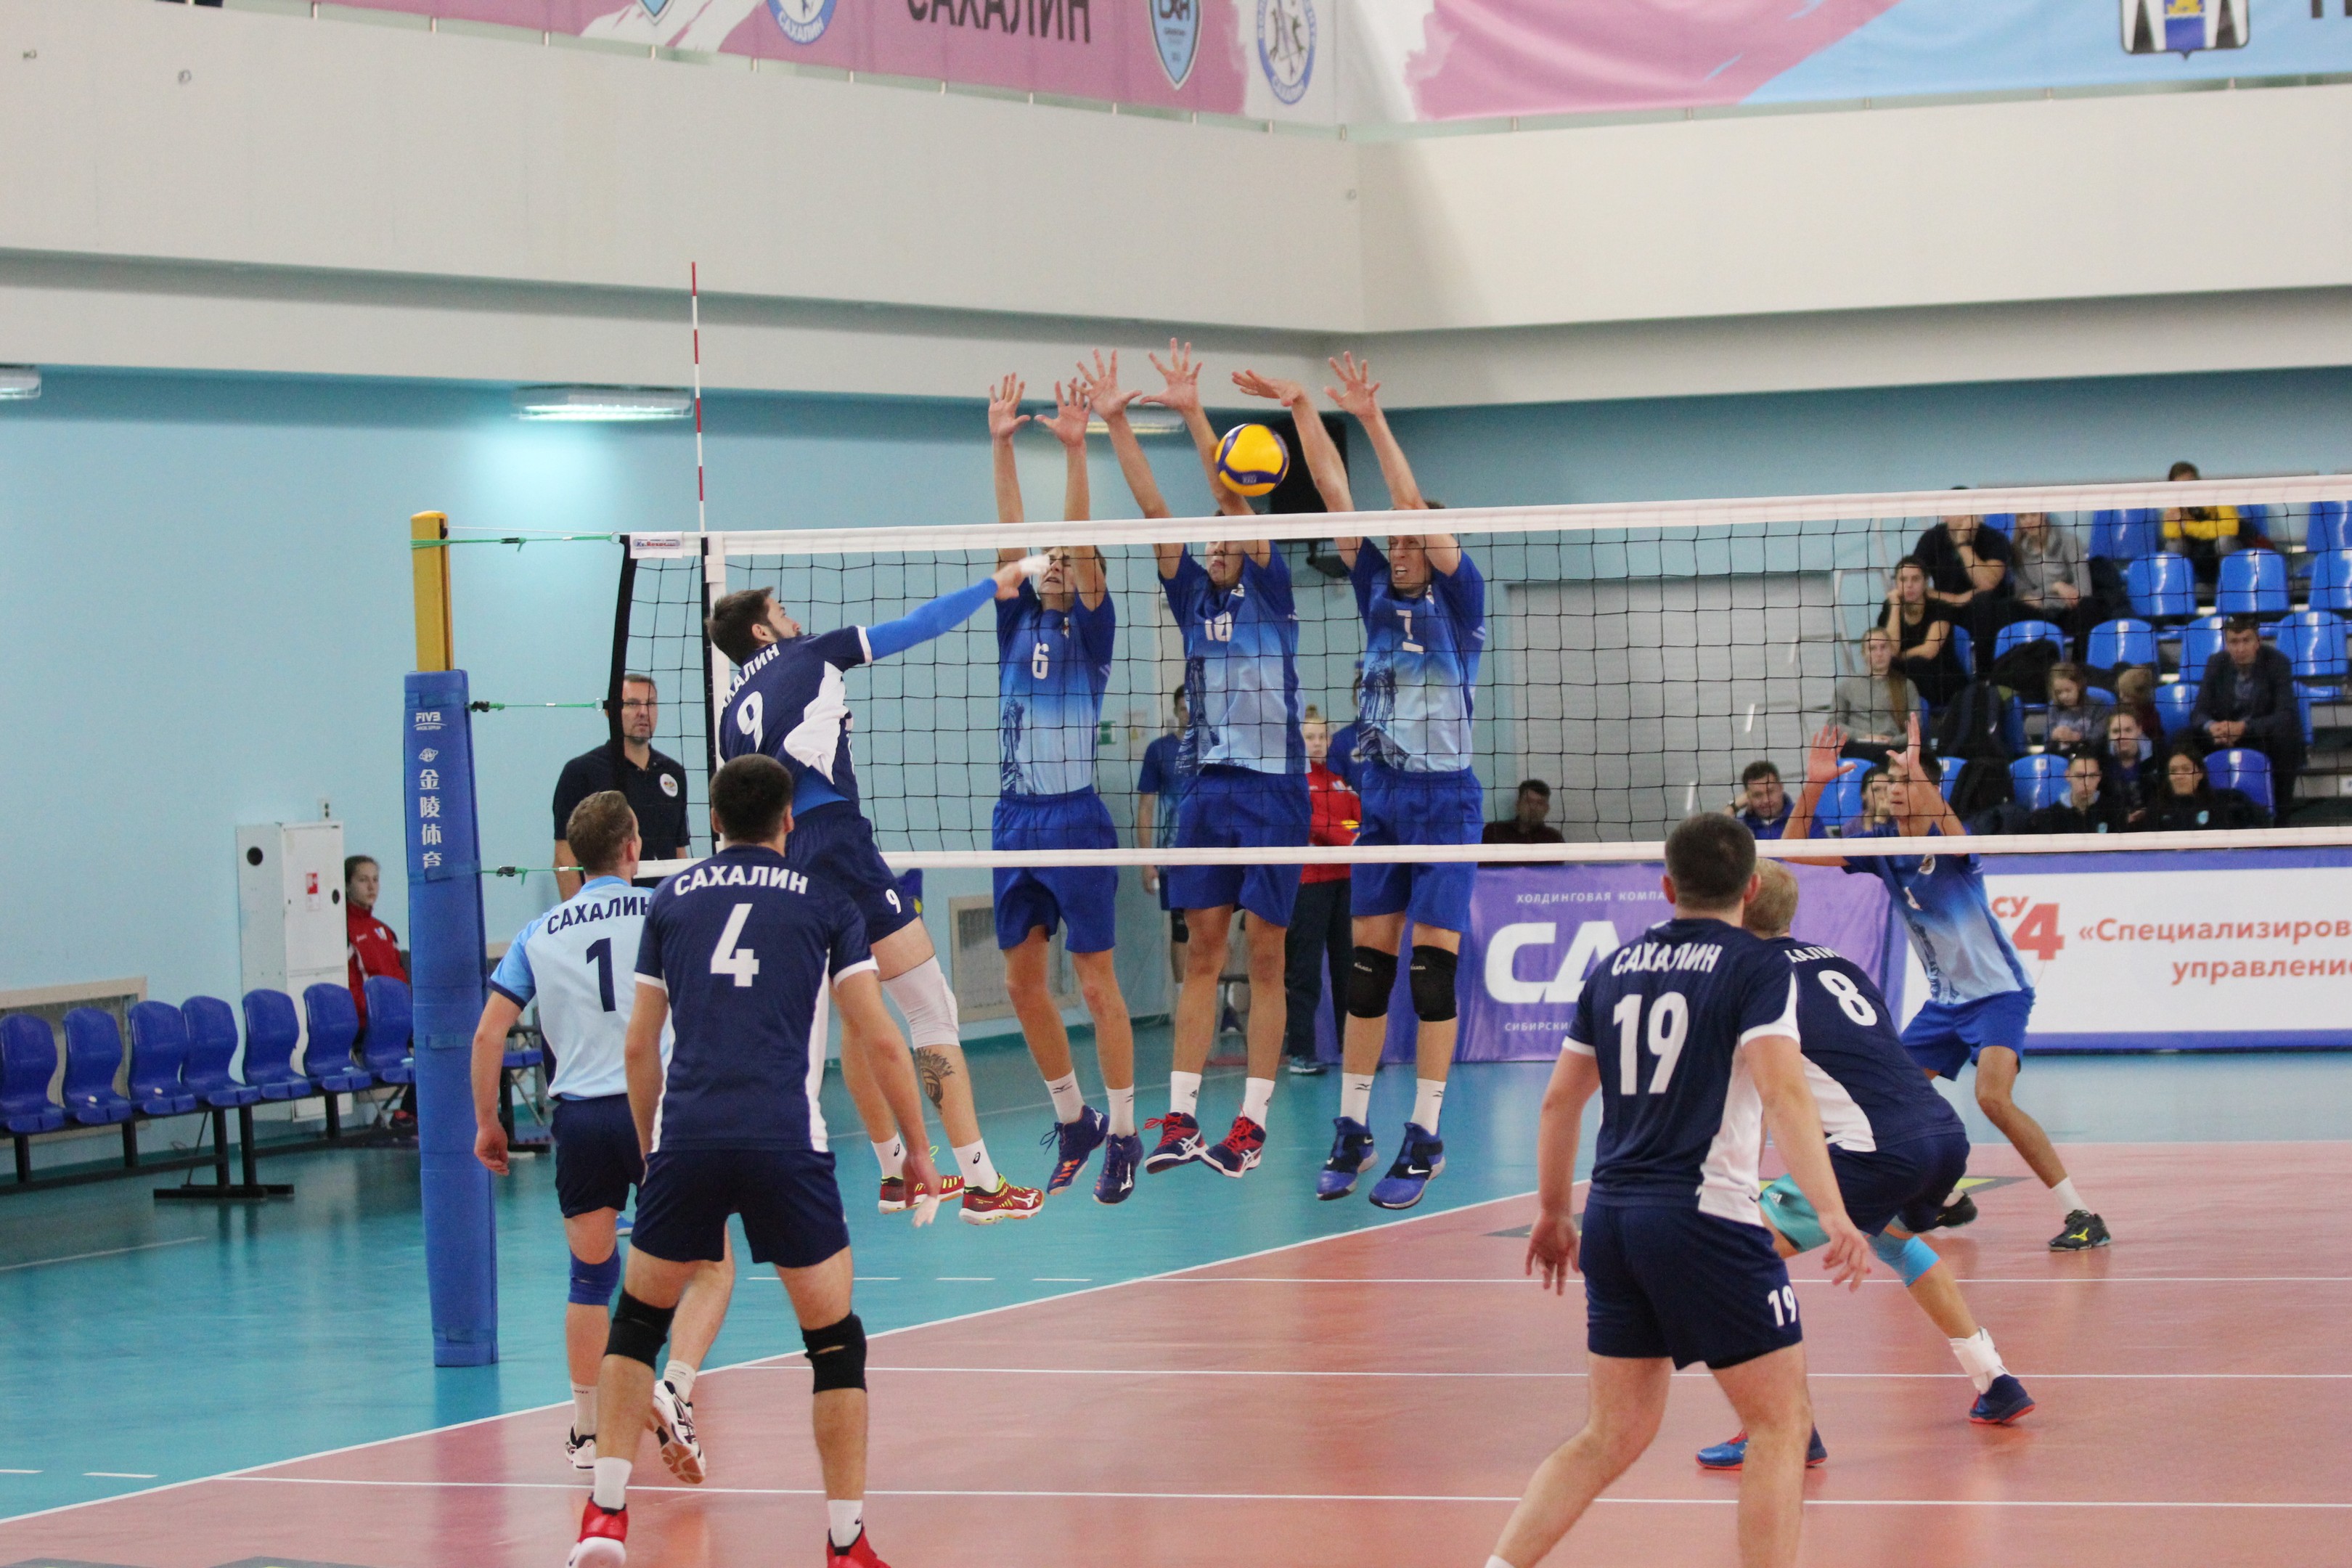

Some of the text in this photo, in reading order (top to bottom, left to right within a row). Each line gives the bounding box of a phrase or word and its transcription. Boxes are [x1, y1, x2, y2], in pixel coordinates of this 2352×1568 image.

[1032, 642, 1050, 679] 6
[415, 711, 441, 722] FIVB
[737, 690, 764, 753] 9
[420, 769, 442, 870] 金陵体育
[674, 865, 809, 896] САХАЛИН
[1516, 892, 1612, 905] ХОЛДИНГОВАЯ
[547, 896, 651, 934] САХАЛИН
[886, 889, 902, 914] 9
[1991, 896, 2030, 918] СУ
[709, 903, 759, 987] 4
[2012, 902, 2065, 960] 4
[2078, 918, 2352, 944] «Специализиров
[586, 937, 616, 1012] 1
[1612, 942, 1723, 976] САХАЛИН
[1818, 970, 1878, 1026] 8
[1505, 1022, 1572, 1032] СИБИРСКИ
[1613, 991, 1689, 1095] 19
[1768, 1285, 1797, 1327] 19
